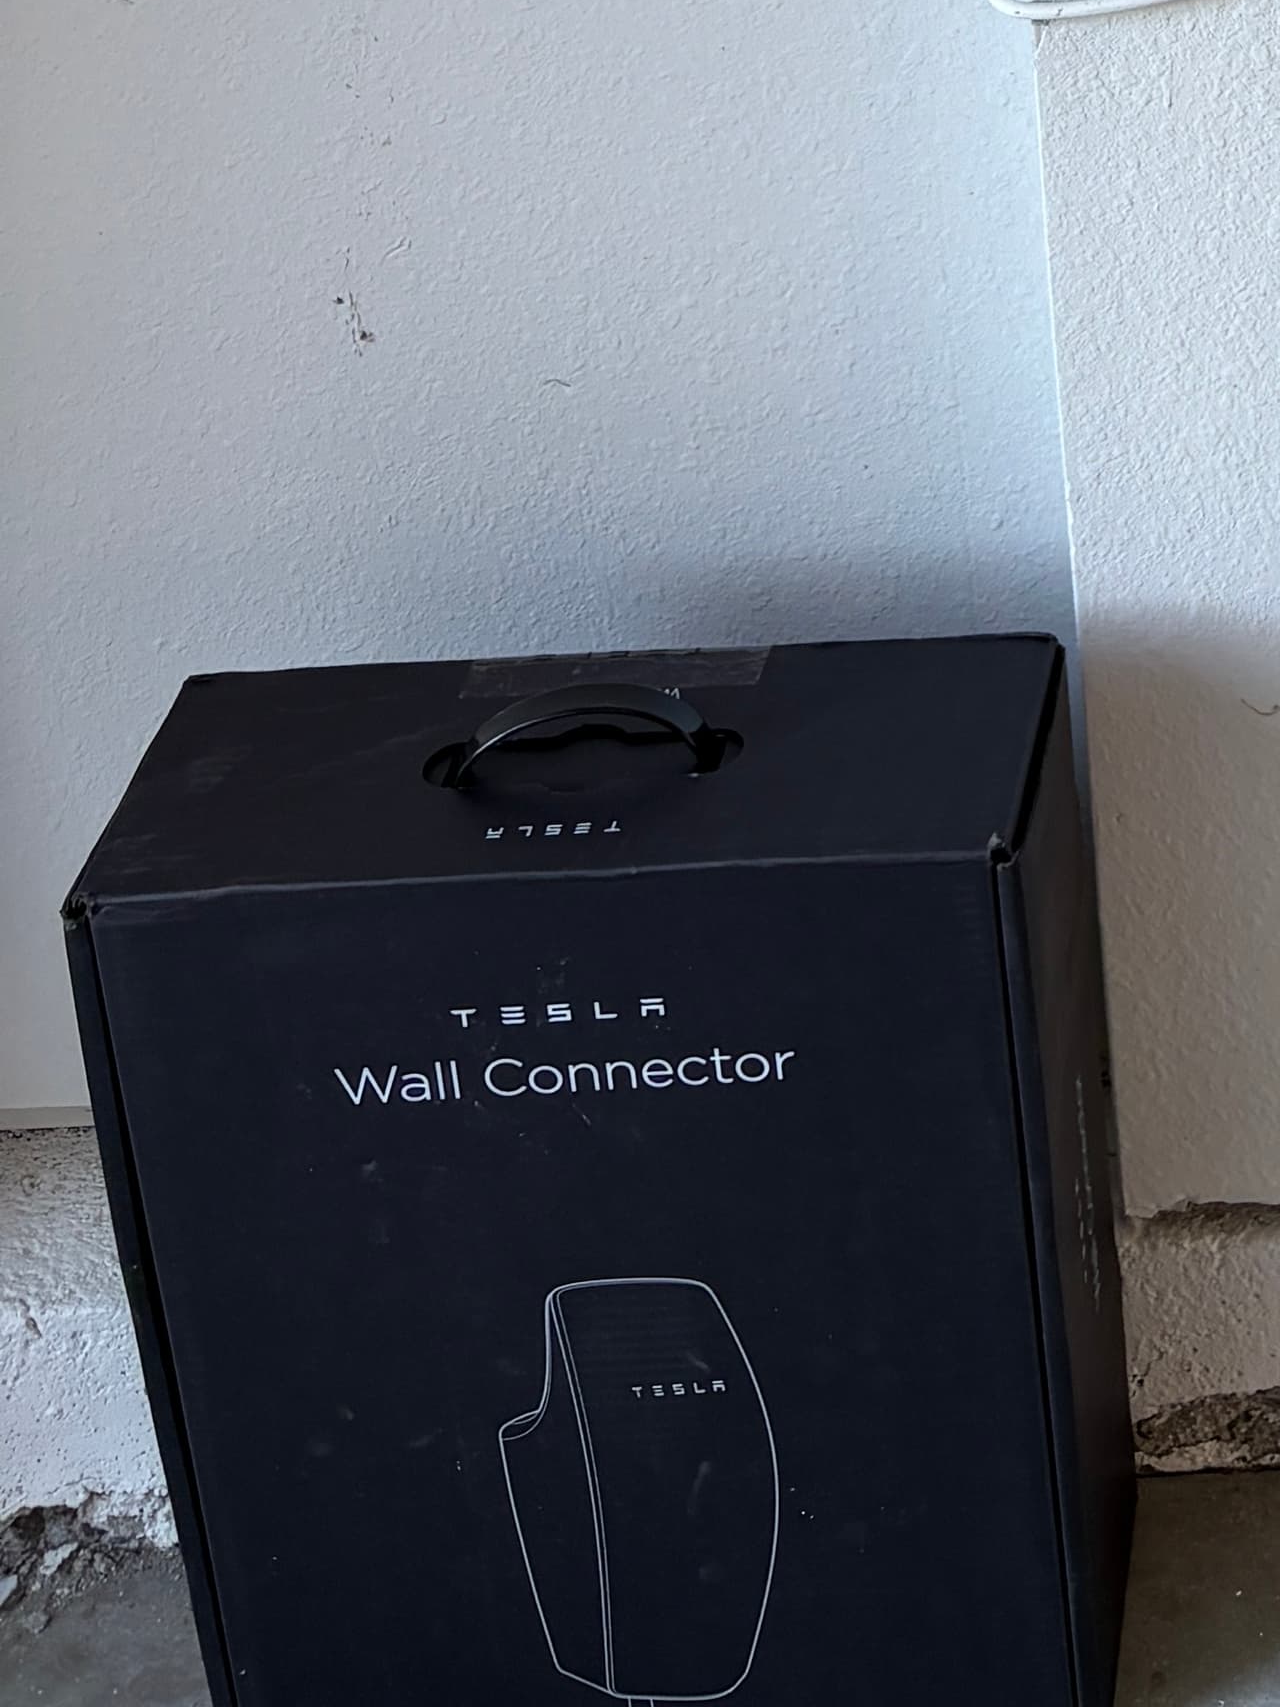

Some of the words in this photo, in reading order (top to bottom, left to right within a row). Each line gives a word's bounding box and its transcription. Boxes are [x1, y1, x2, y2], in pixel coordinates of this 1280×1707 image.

[485, 820, 621, 839] TESLA
[450, 997, 666, 1028] TESLA
[333, 1059, 462, 1105] Wall
[484, 1047, 796, 1097] Connector
[631, 1380, 726, 1398] TESLA
